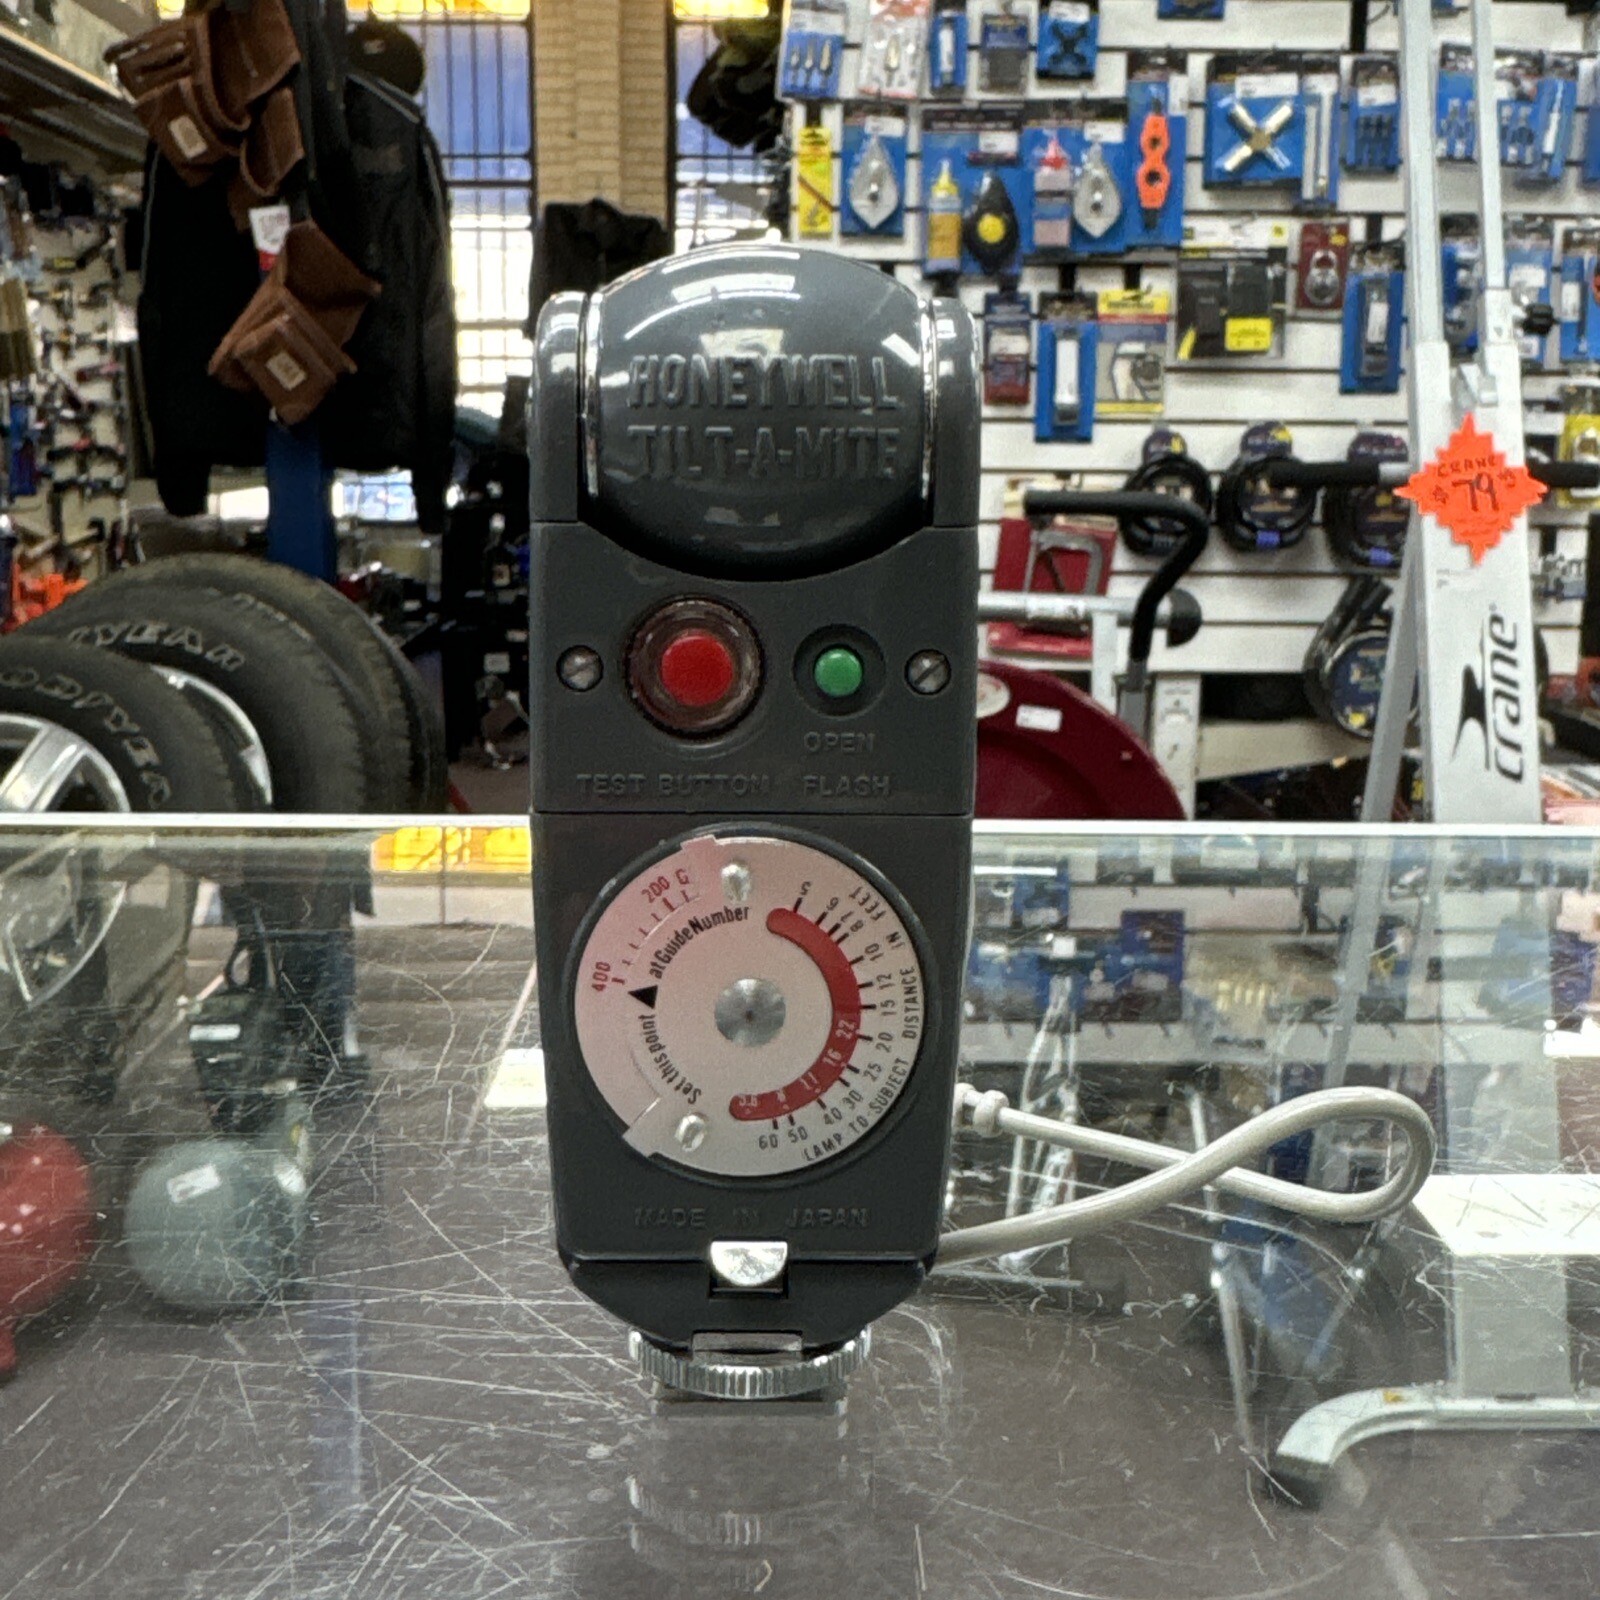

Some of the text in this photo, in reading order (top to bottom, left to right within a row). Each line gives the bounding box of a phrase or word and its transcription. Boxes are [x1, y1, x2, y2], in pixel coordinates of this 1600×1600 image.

[628, 353, 901, 409] HONEYWELL
[627, 424, 901, 478] TILT-A-MITE
[1489, 612, 1524, 784] crane
[803, 731, 875, 753] OPEN
[576, 773, 769, 797] TEST BUTTON
[803, 775, 890, 797] FLASH
[641, 876, 670, 904] 200
[849, 886, 886, 922] FEET
[850, 919, 864, 933] 8
[649, 905, 751, 979] at Guide Number
[864, 942, 884, 961] 10
[886, 931, 906, 950] IN
[591, 961, 611, 993] 400
[876, 973, 895, 990] 12
[880, 999, 897, 1016] 15
[900, 966, 921, 1040] DISTANCE
[835, 1019, 857, 1040] 22
[875, 1031, 894, 1053] 20
[638, 1014, 702, 1105] Set this point
[822, 1048, 842, 1067] 16
[862, 1062, 883, 1082] 25
[869, 1058, 909, 1114] SUBJECT
[843, 1090, 862, 1110] 30
[823, 1107, 843, 1126] 40
[758, 1133, 778, 1150] 60
[788, 1126, 809, 1143] 50
[802, 1132, 843, 1162] LAMP
[634, 1207, 870, 1228] MADE IN JAPAN
